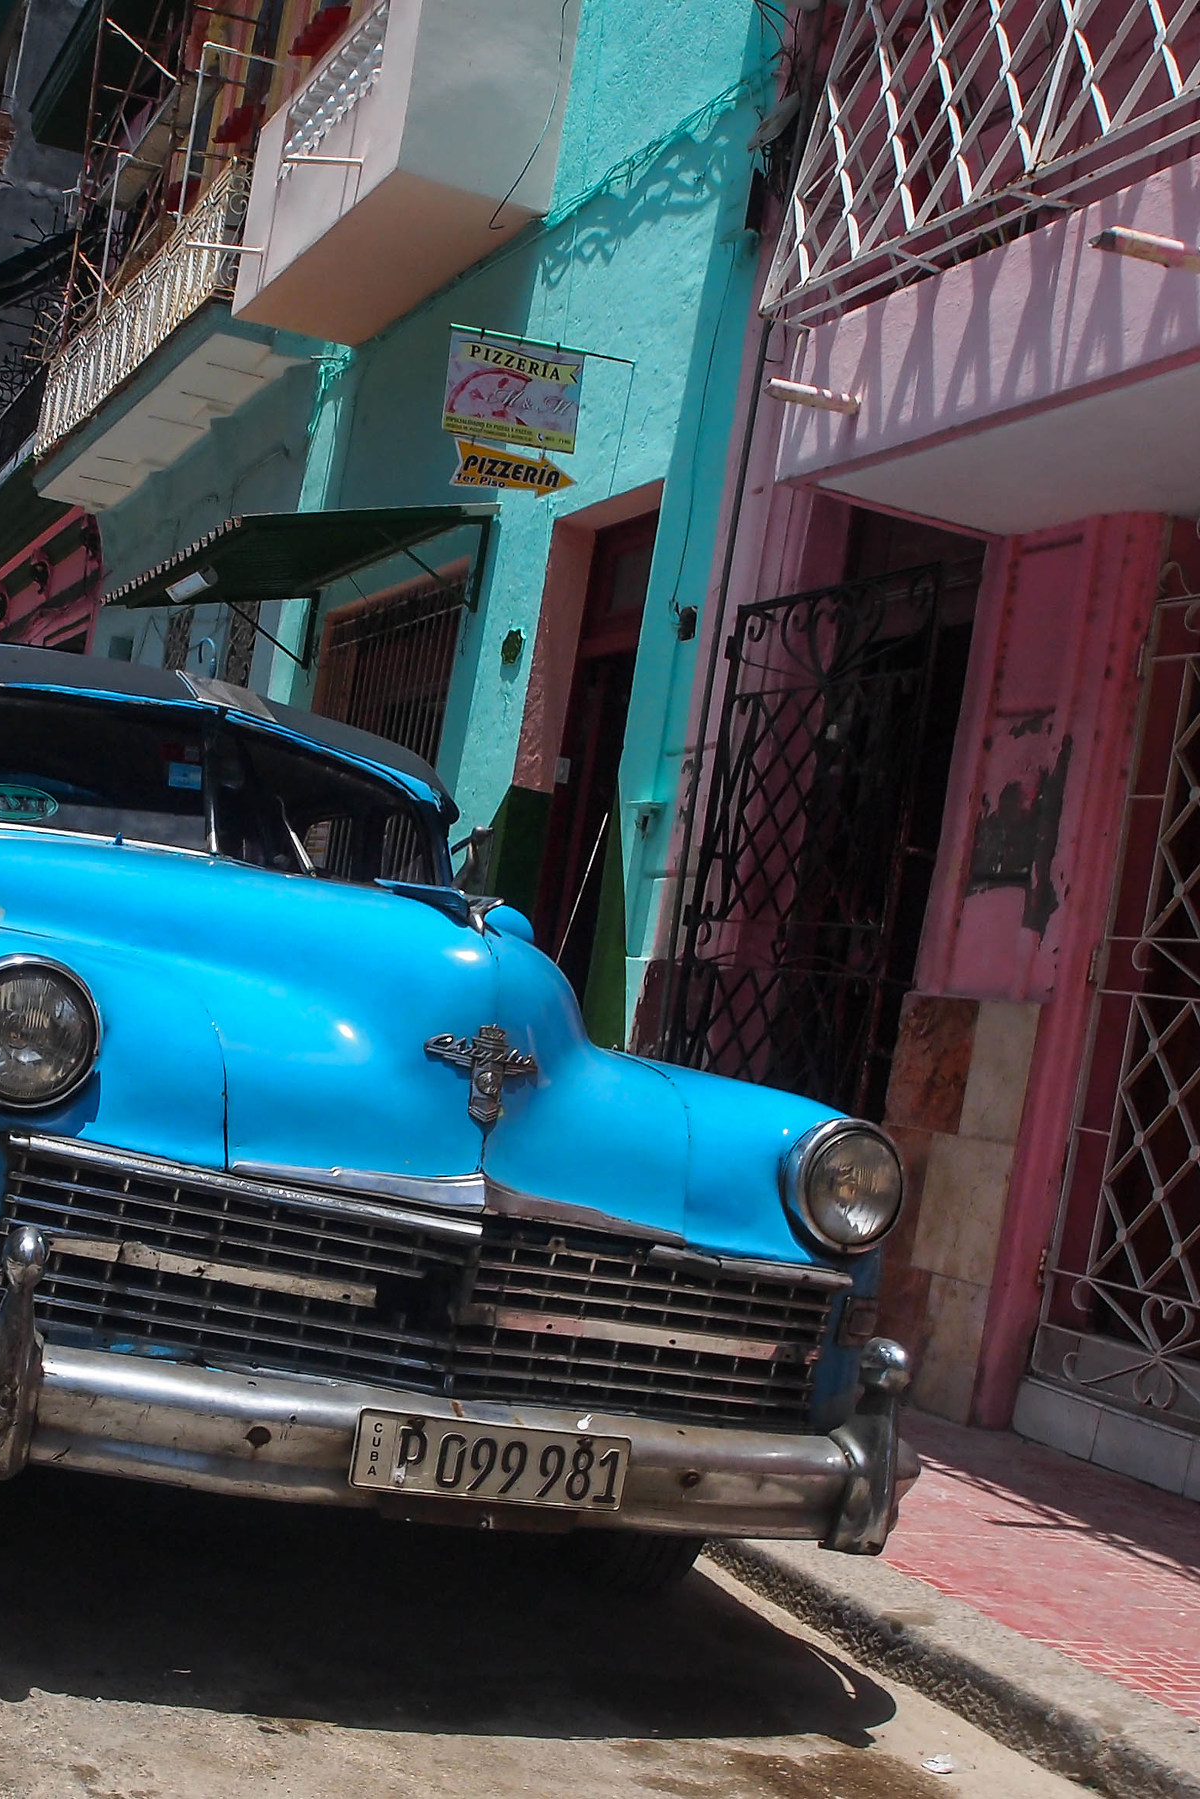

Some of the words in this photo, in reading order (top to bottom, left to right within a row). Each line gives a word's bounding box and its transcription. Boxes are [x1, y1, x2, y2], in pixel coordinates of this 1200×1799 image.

[469, 345, 560, 381] PIZZERÍA
[456, 472, 475, 484] 1er
[479, 476, 506, 489] Piso
[462, 455, 560, 488] PIZZERÍA
[366, 1422, 383, 1477] CUBA
[535, 1444, 621, 1504] 981
